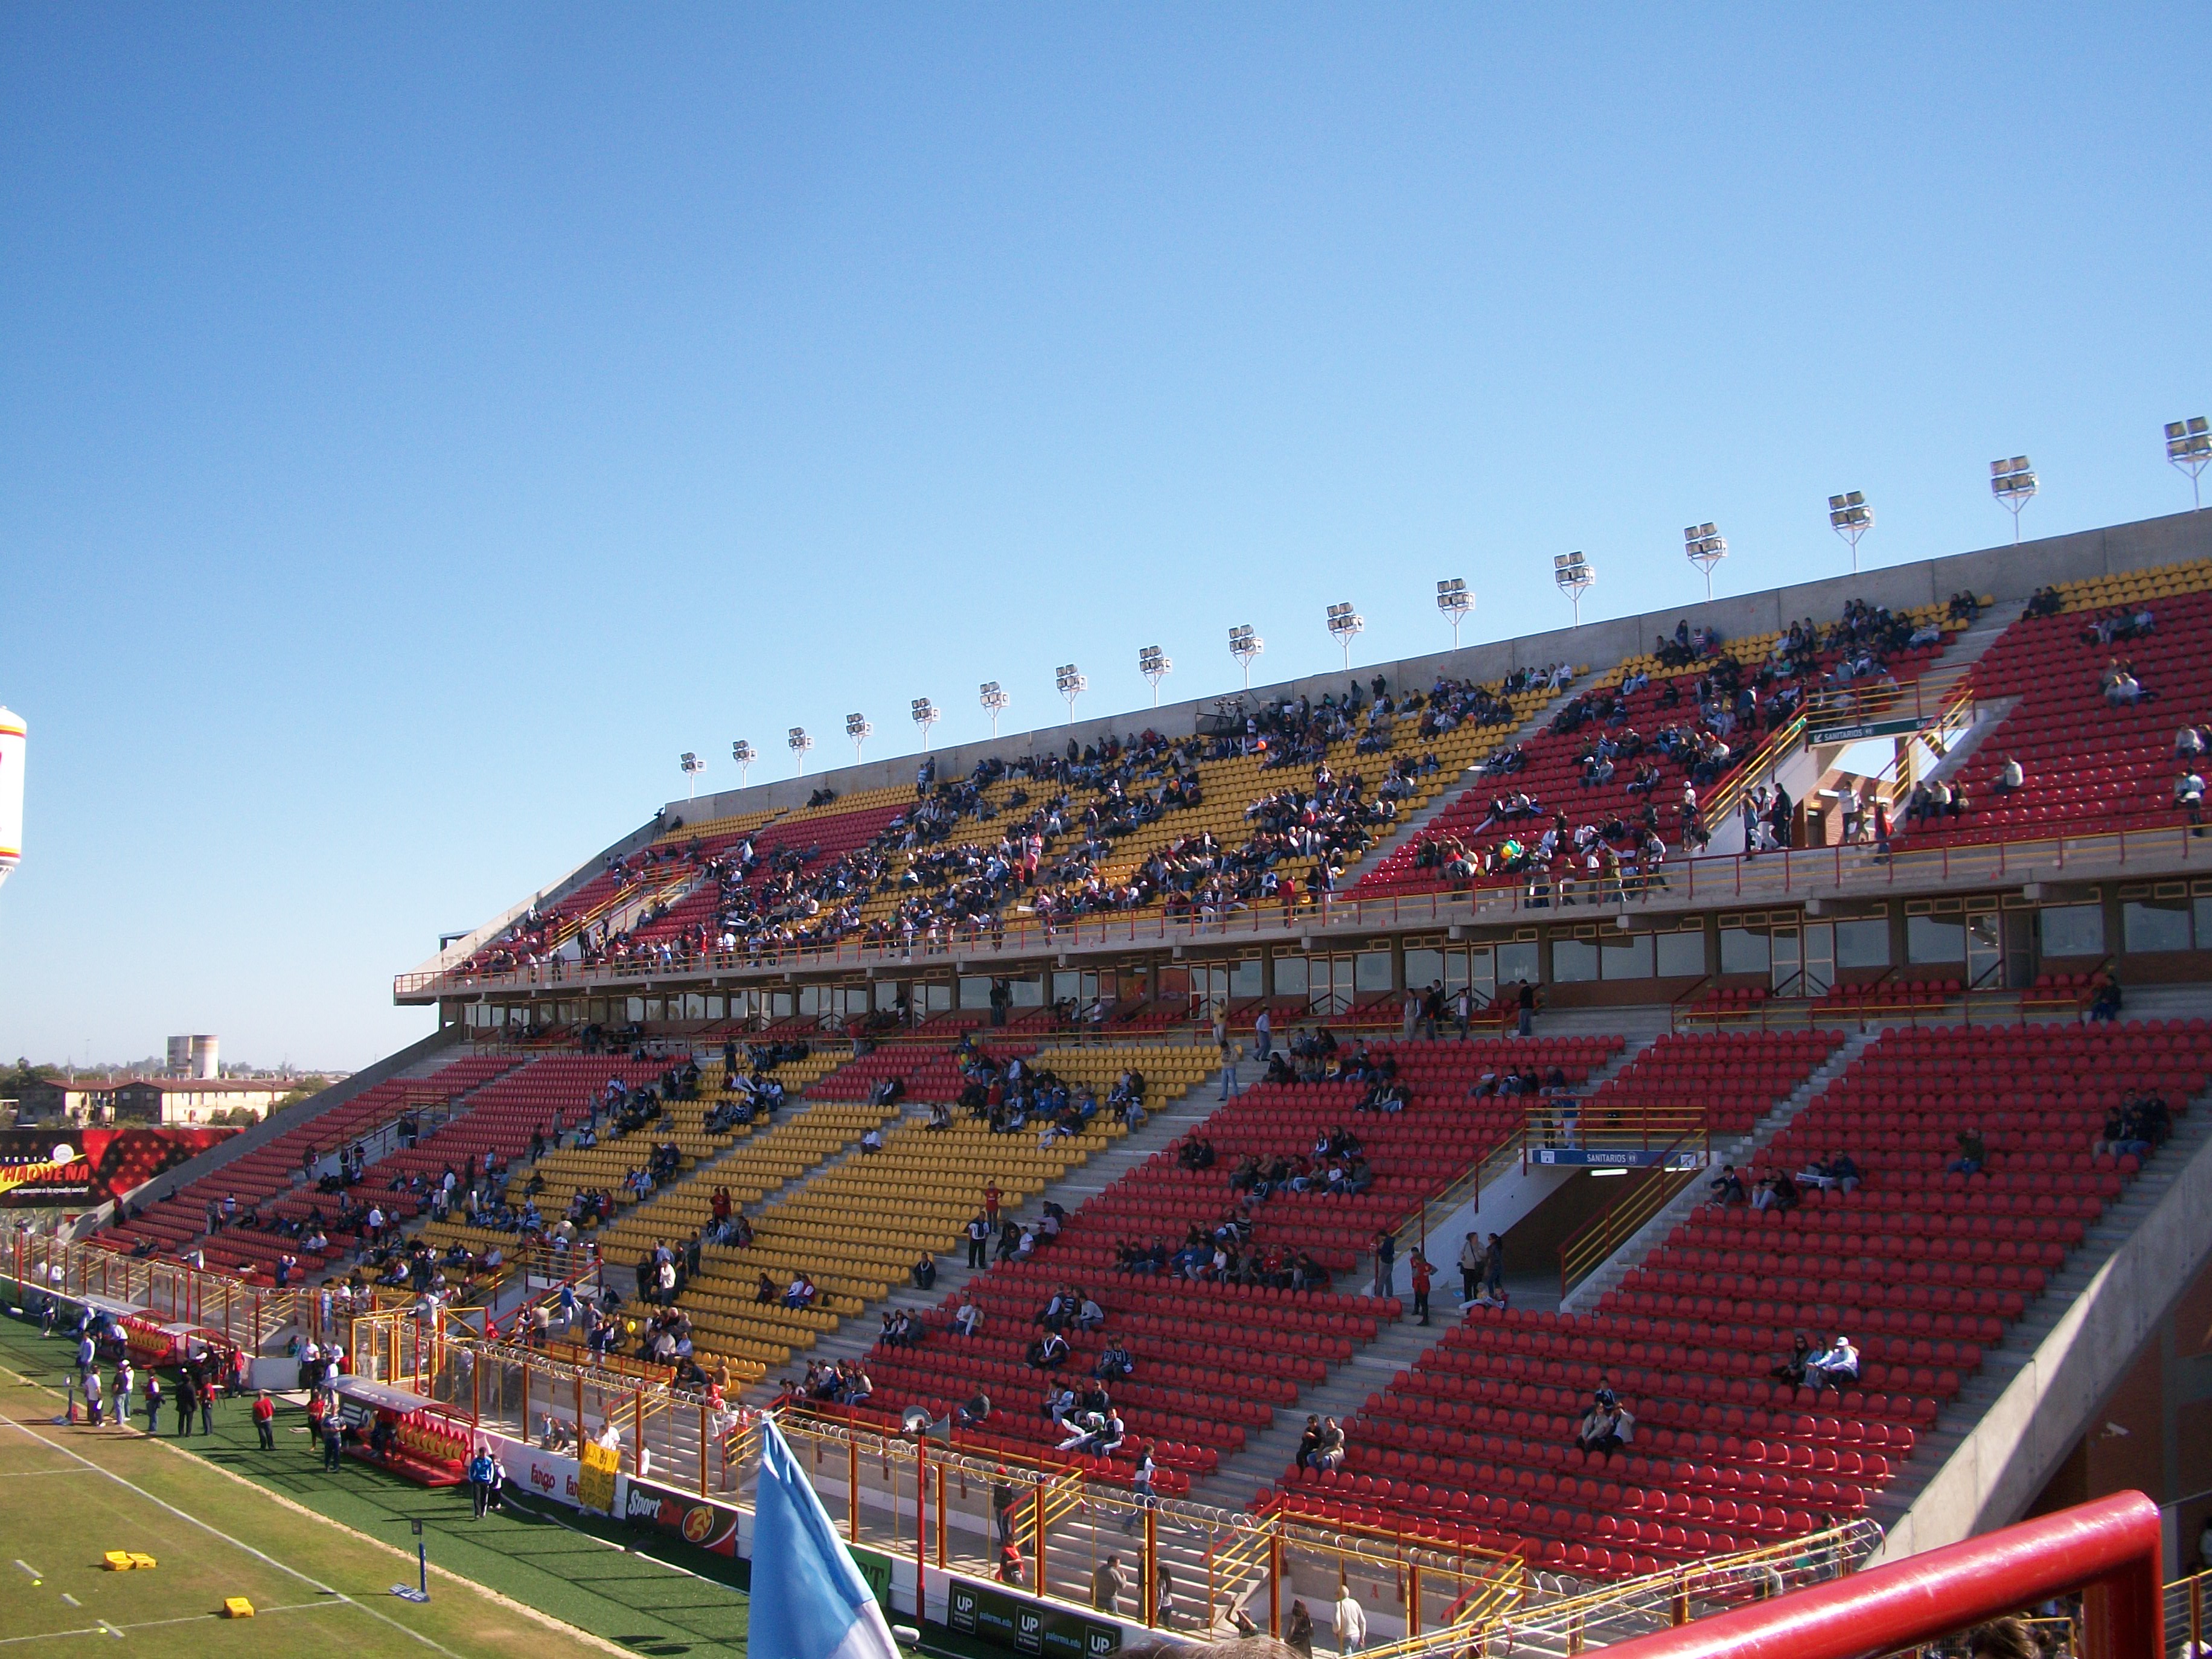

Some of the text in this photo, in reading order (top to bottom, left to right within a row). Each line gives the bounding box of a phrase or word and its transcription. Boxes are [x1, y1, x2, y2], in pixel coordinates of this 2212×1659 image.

[1916, 718, 1942, 729] SADA
[1824, 729, 1862, 742] SANITARIOS
[1587, 1154, 1626, 1163] SANITARIOS
[0, 1163, 89, 1183] HAQUEÑA
[531, 1463, 555, 1492] fango
[566, 1474, 580, 1497] fan
[627, 1489, 662, 1519] Sport
[957, 1594, 973, 1612] UP
[979, 1611, 1012, 1628] palermo.edu
[1021, 1614, 1038, 1632] UP
[1046, 1632, 1081, 1649] palermo.edu
[1091, 1634, 1110, 1653] UP
